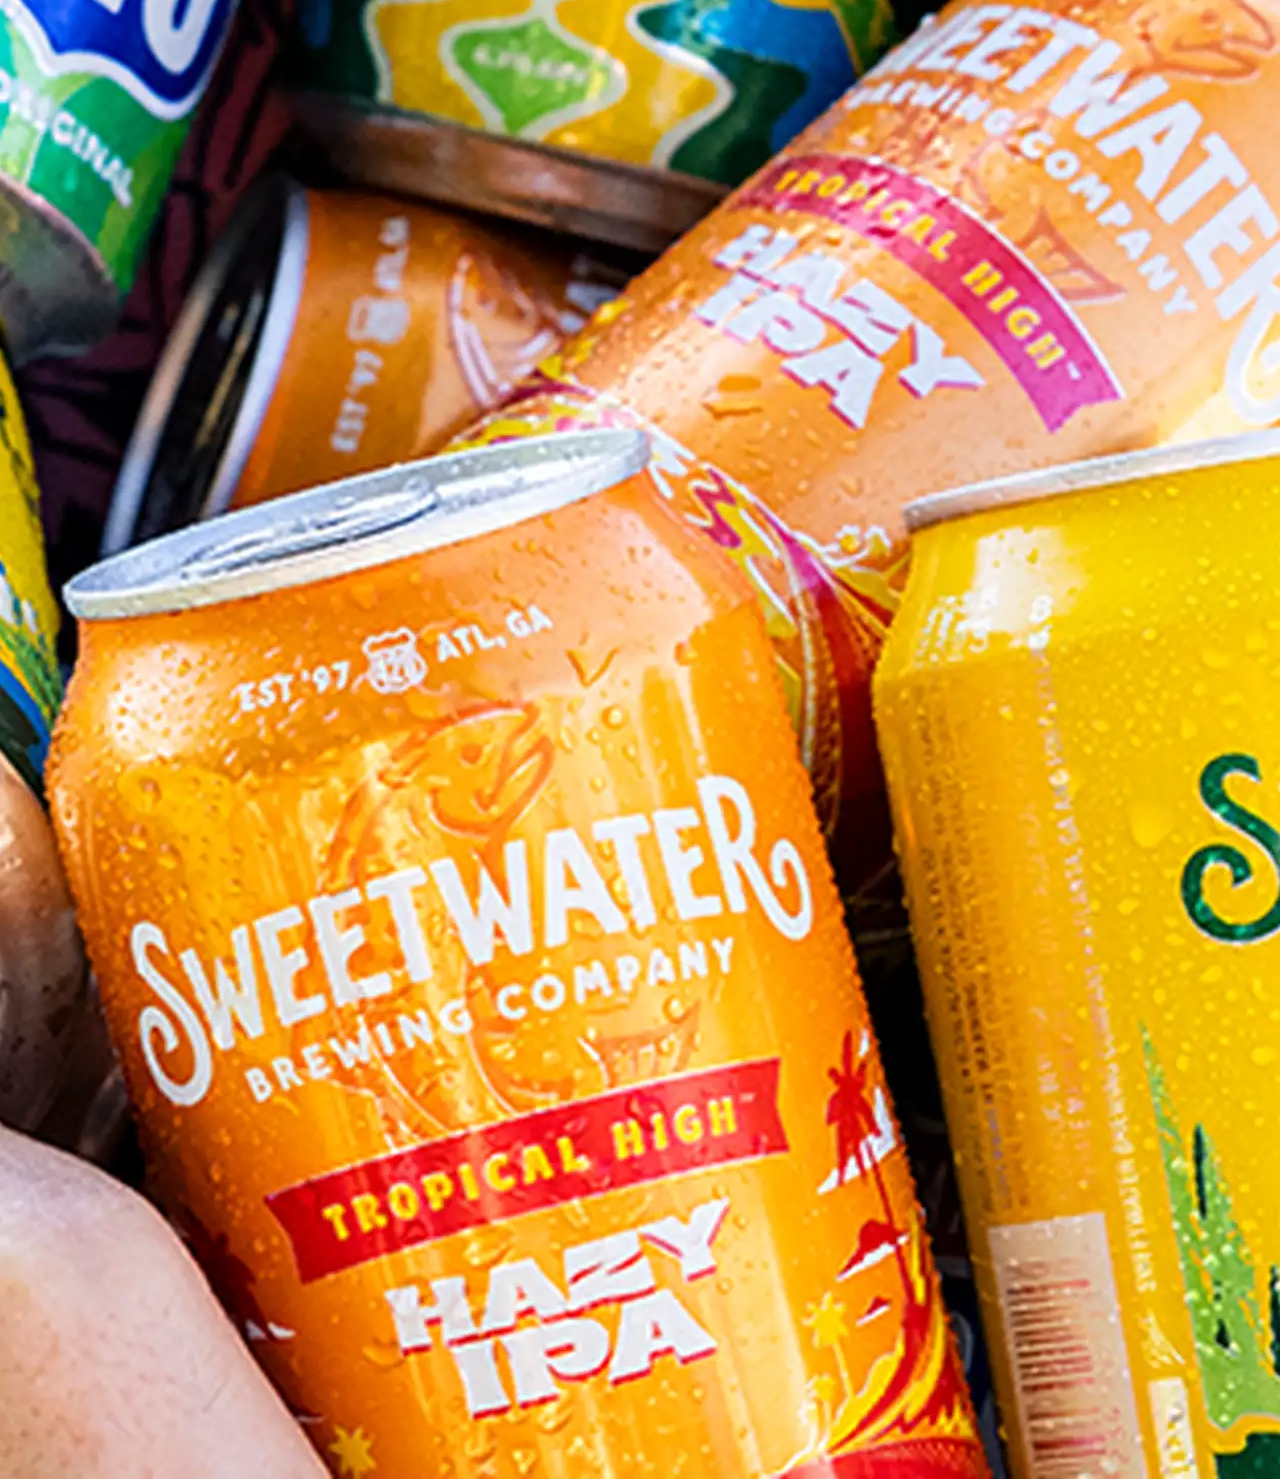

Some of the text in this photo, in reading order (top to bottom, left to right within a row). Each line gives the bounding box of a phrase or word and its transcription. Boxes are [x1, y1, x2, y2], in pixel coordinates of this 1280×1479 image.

[773, 166, 953, 262] TROPICAL
[1021, 117, 1199, 319] COMPANY
[695, 274, 887, 432] IPA
[715, 222, 986, 398] HAZY
[236, 679, 291, 714] EST
[302, 661, 351, 696] '97
[436, 623, 507, 665] ATL,
[506, 603, 554, 638] GA
[129, 774, 815, 1108] SWEETWATER
[244, 936, 736, 1104] BREWING COMPANY
[321, 1135, 589, 1244] TROPICAL
[386, 1198, 730, 1356] HAZY
[449, 1286, 719, 1421] IPA
